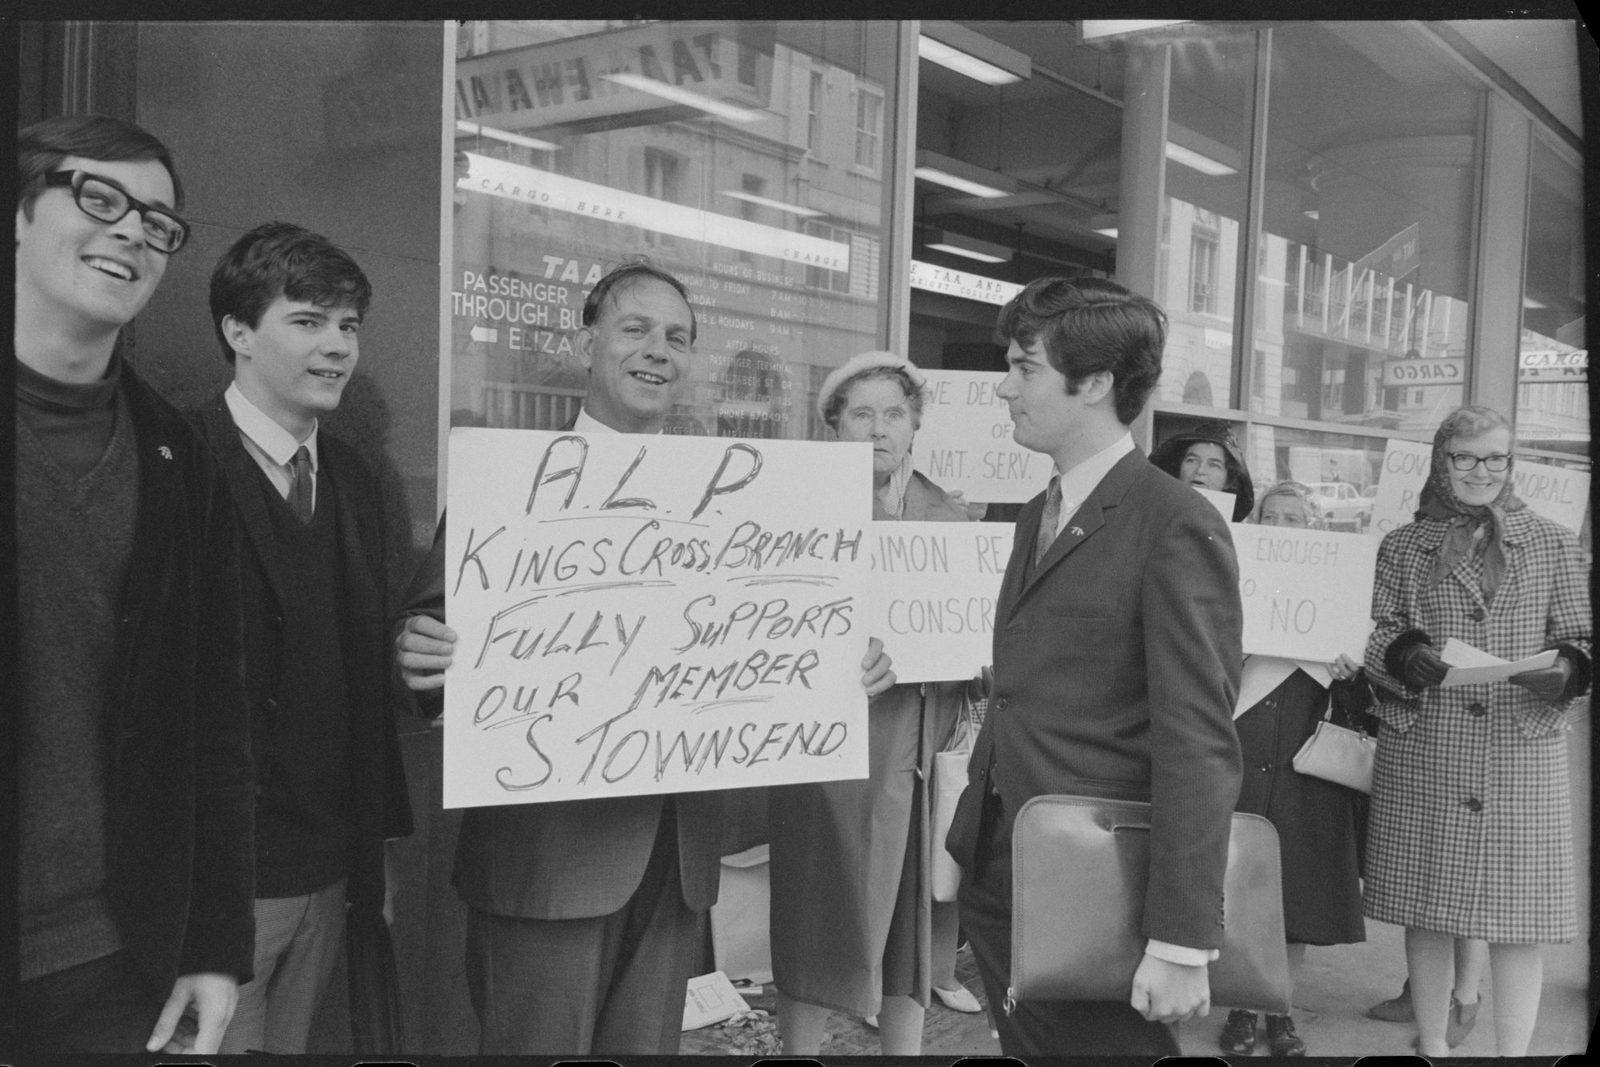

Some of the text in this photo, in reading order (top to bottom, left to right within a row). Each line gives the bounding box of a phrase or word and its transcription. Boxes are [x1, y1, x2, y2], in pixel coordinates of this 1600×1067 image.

[481, 178, 626, 220] CARGO HERE
[542, 254, 602, 285] TAA
[713, 262, 738, 277] HOURS
[934, 269, 961, 285] TAA
[976, 279, 1002, 293] AND
[464, 270, 568, 304] PASSENGER
[724, 280, 750, 295] FRIDAY
[451, 291, 548, 326] THROUGH
[718, 317, 755, 332] HOLIDAYS
[1523, 353, 1588, 367] CARG
[719, 407, 745, 420] PHONE
[929, 449, 1033, 480] NAT. SERV.
[452, 525, 614, 598] KINGS
[713, 519, 864, 572] BRANCH
[1256, 537, 1339, 567] ENOUGH
[887, 596, 999, 635] CONSCR
[1269, 598, 1318, 635] NO
[473, 594, 854, 678] FULLY SUPPORTS
[473, 648, 821, 726] OUR MEMBER
